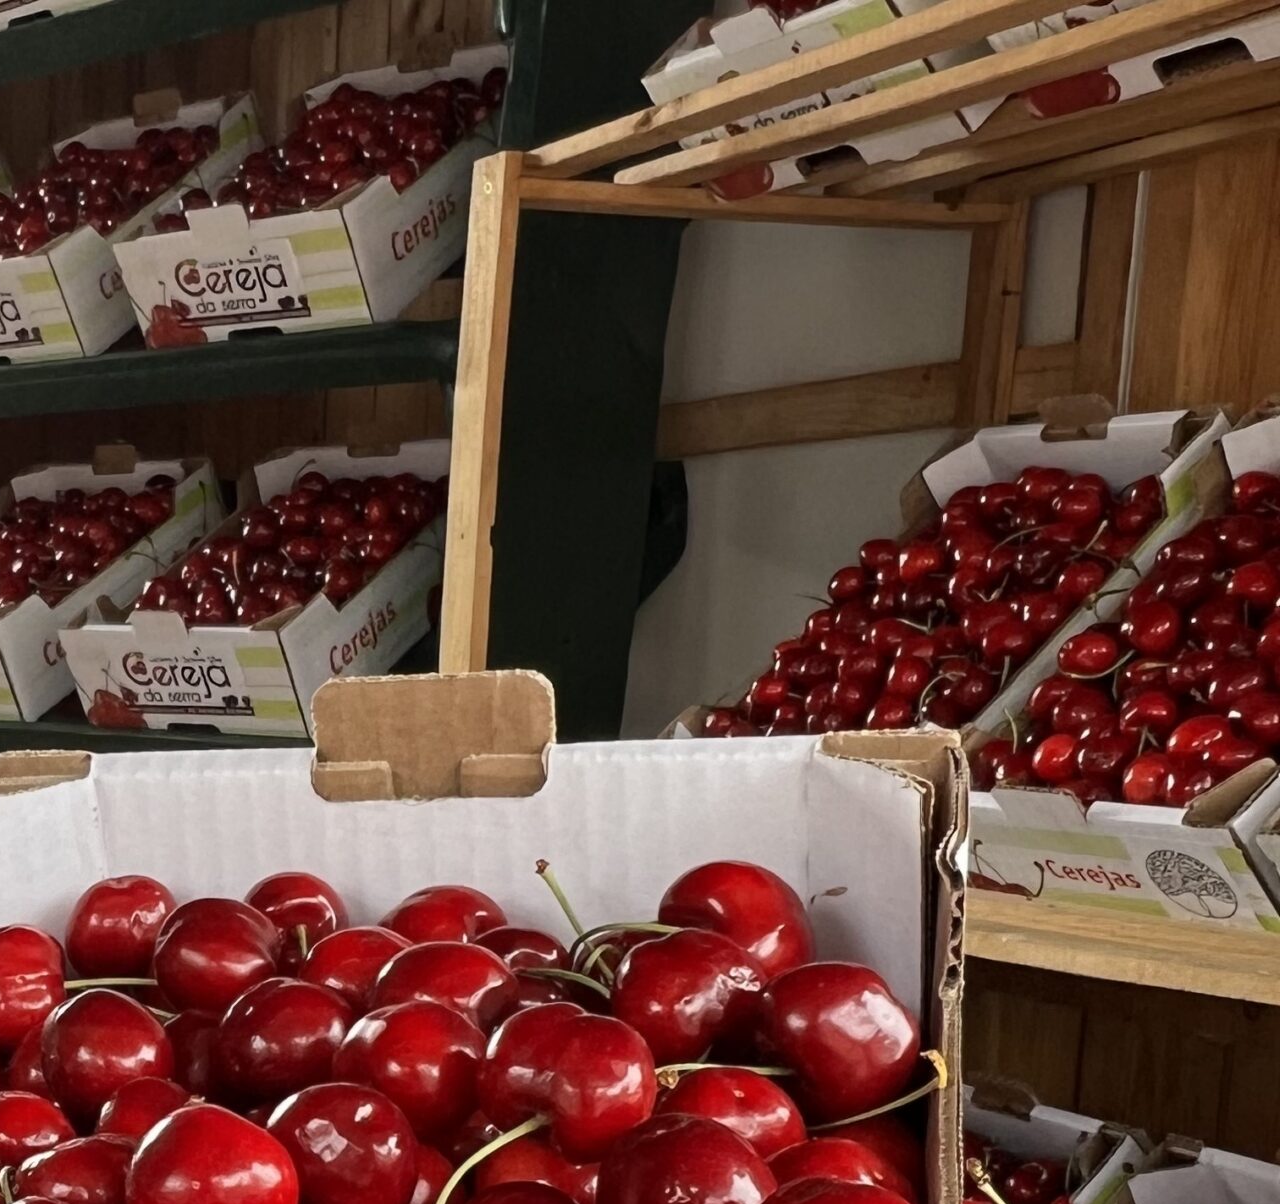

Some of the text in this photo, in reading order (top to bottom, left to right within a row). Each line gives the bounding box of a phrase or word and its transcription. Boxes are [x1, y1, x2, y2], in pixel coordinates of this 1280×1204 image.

[391, 191, 457, 262] Cerejas
[174, 258, 288, 303] Cereja
[329, 600, 397, 675] Cerejas
[122, 651, 232, 699] Cereja
[1045, 859, 1142, 891] Cerejas
